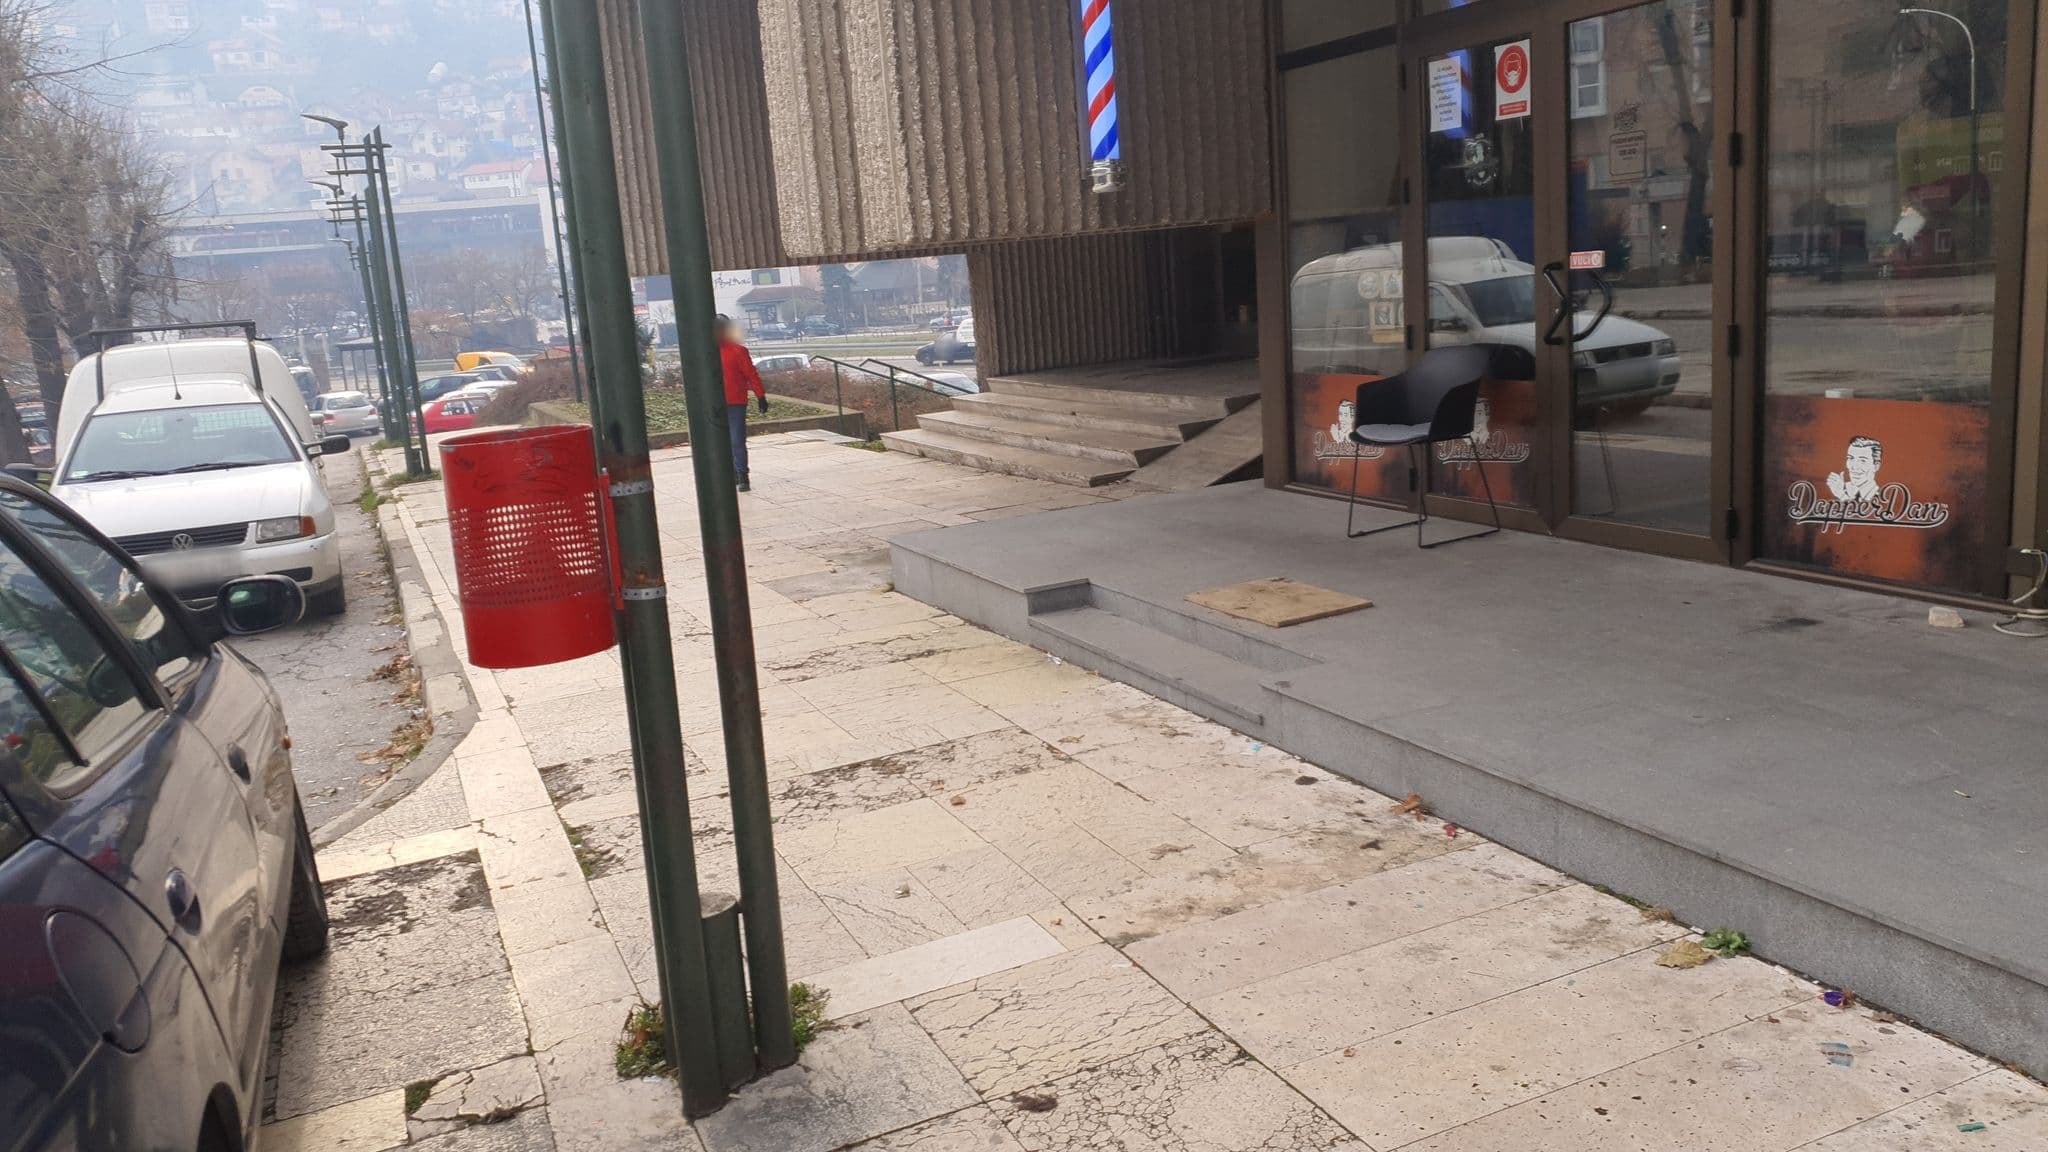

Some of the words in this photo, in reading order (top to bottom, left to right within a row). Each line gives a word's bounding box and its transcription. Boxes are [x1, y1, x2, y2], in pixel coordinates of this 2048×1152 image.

[1572, 255, 1591, 266] VUCI
[1788, 481, 1883, 534] Dapper
[1878, 482, 1949, 529] Dan
